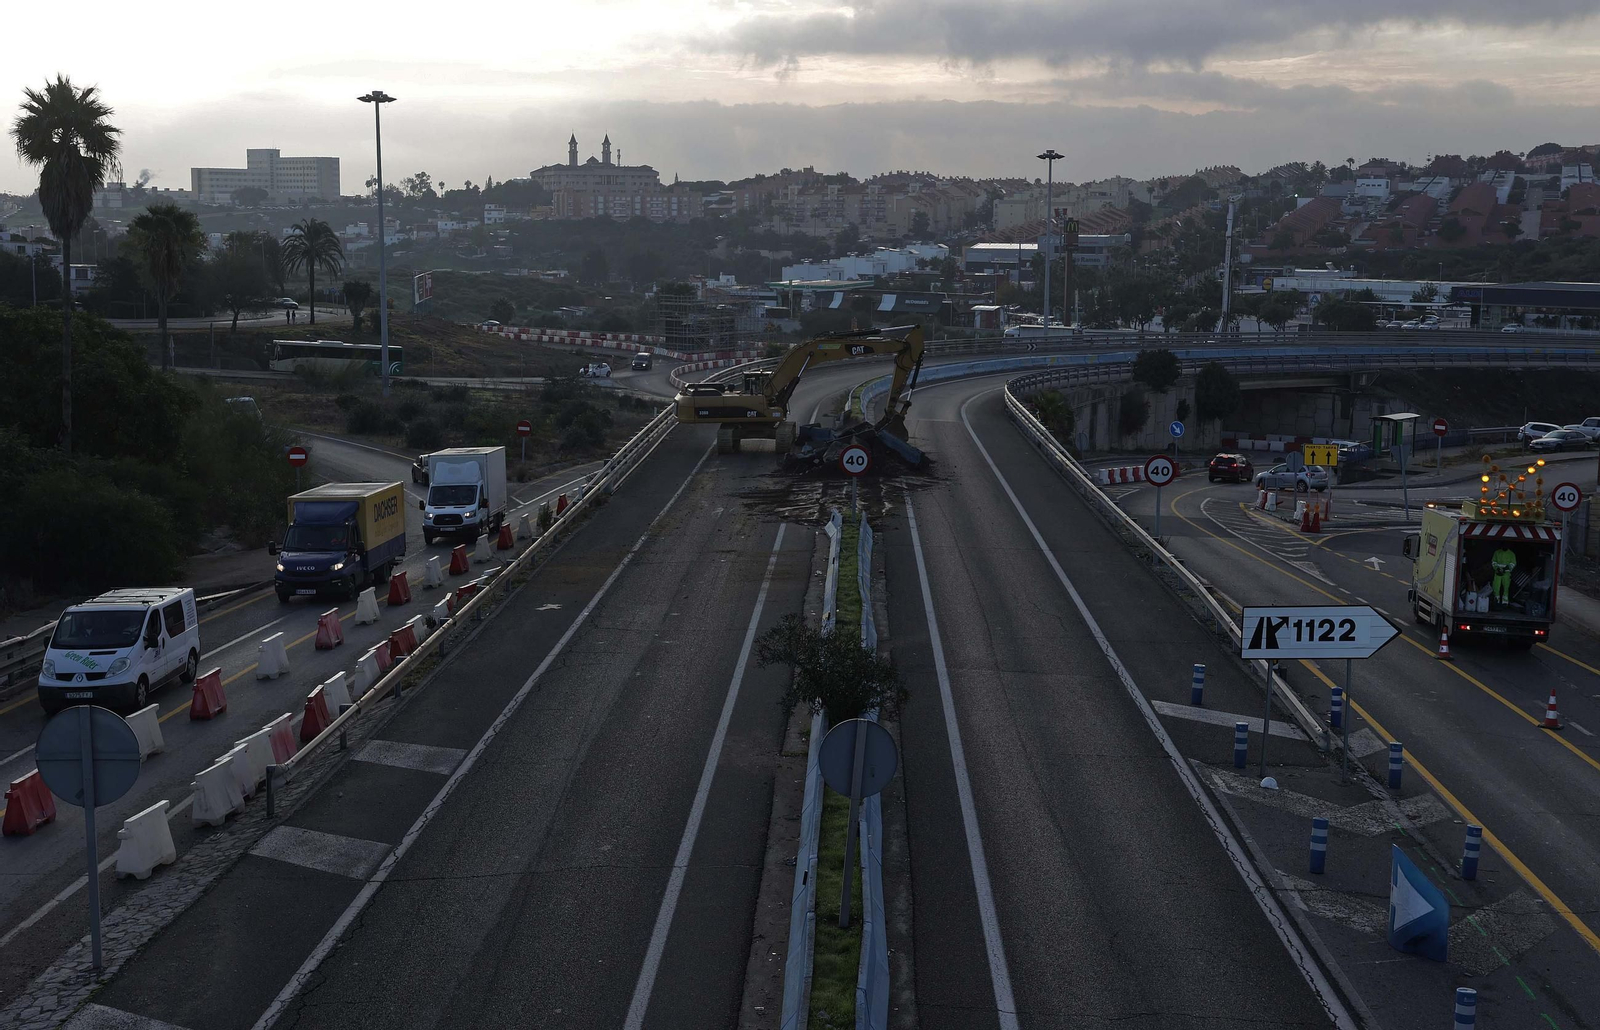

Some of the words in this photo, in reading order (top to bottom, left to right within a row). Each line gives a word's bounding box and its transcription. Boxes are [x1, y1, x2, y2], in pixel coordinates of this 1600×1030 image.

[852, 346, 865, 355] CAT
[845, 455, 865, 466] 40
[1151, 466, 1170, 477] 40
[1557, 492, 1576, 502] 40
[373, 496, 398, 523] DACHSER
[1293, 619, 1356, 642] 1122
[65, 651, 81, 663] Green
[80, 656, 99, 670] Rider
